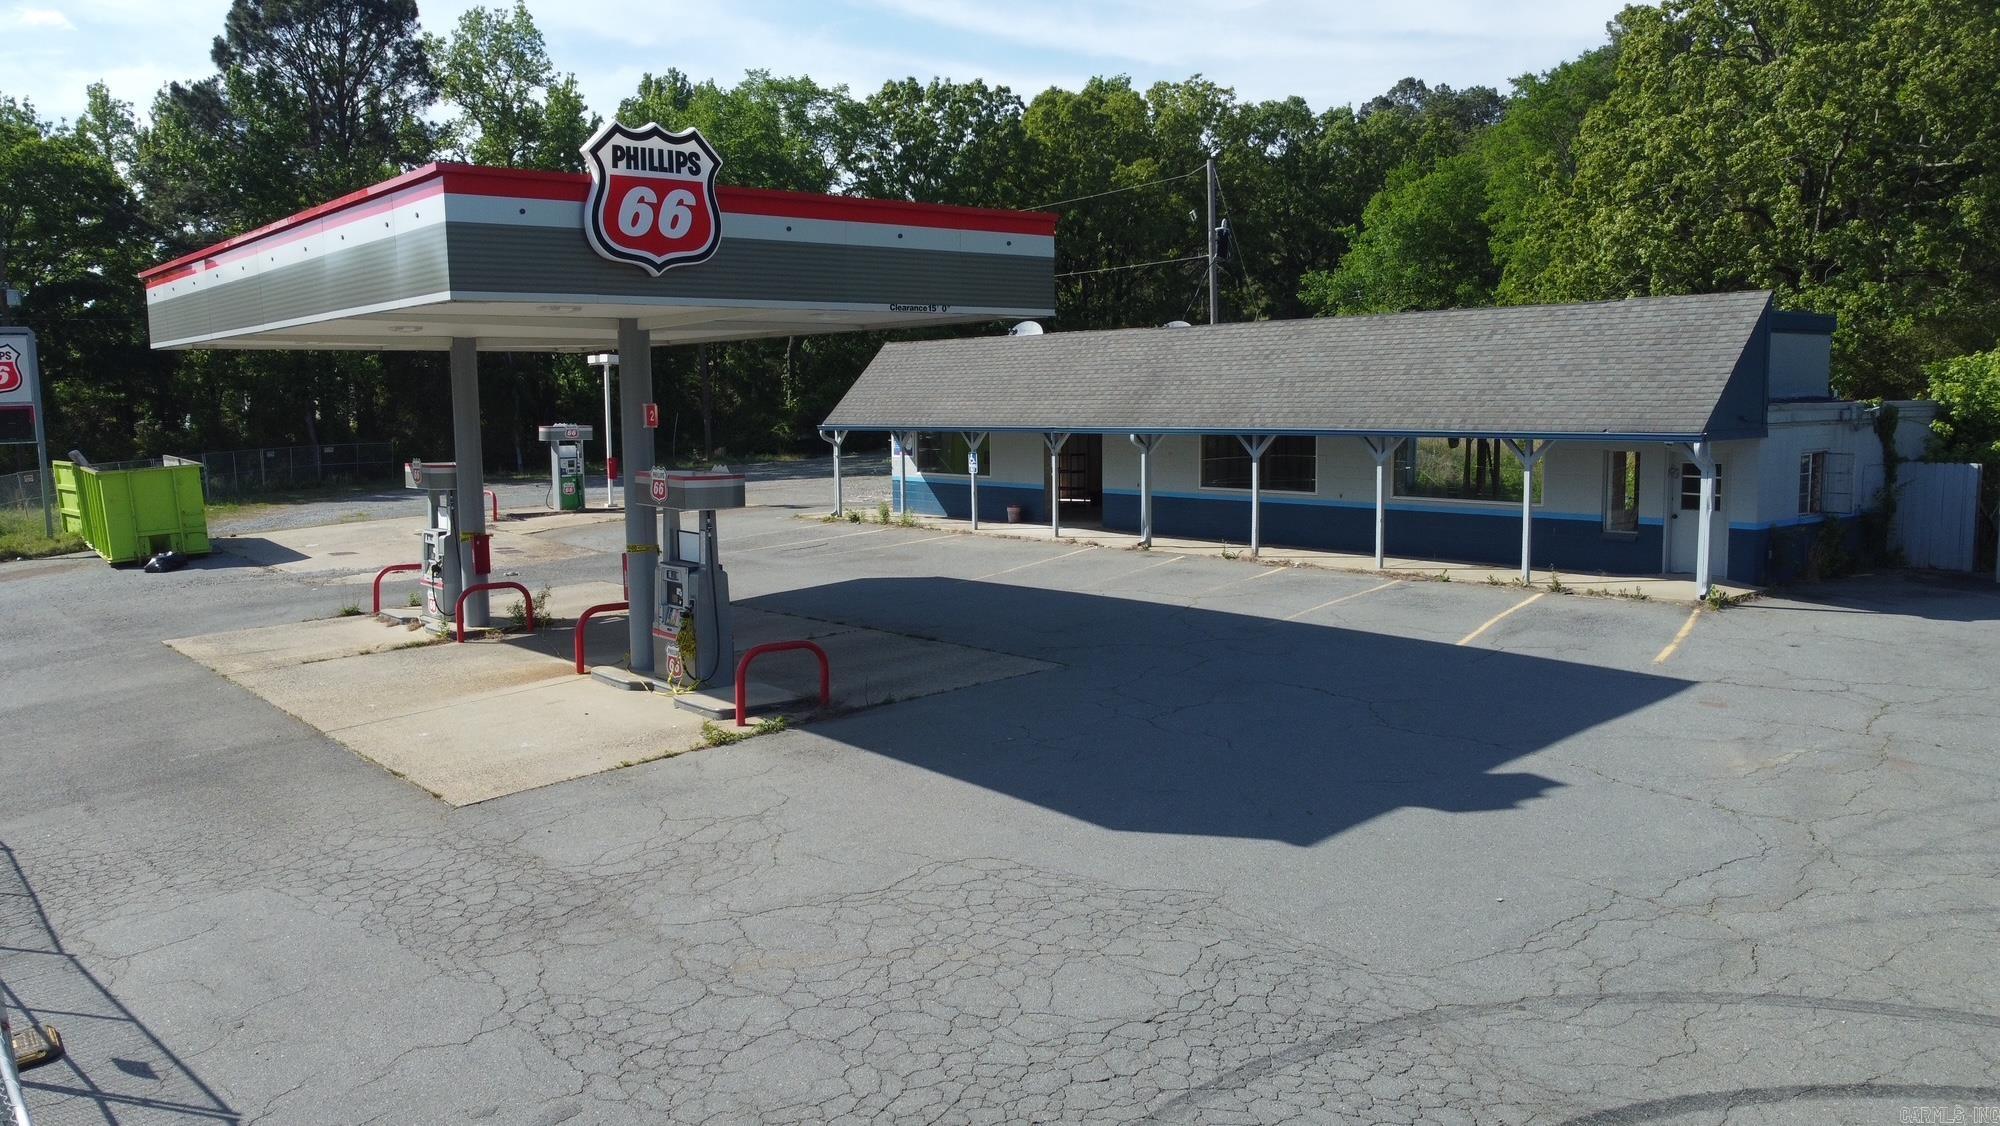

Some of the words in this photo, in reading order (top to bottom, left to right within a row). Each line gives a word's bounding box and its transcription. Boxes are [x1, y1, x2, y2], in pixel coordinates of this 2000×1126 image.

[611, 144, 702, 177] PHILLIPS
[618, 186, 697, 239] 66
[889, 303, 928, 312] Clearance
[649, 409, 655, 421] 2
[653, 481, 665, 495] 66
[669, 658, 681, 673] 66
